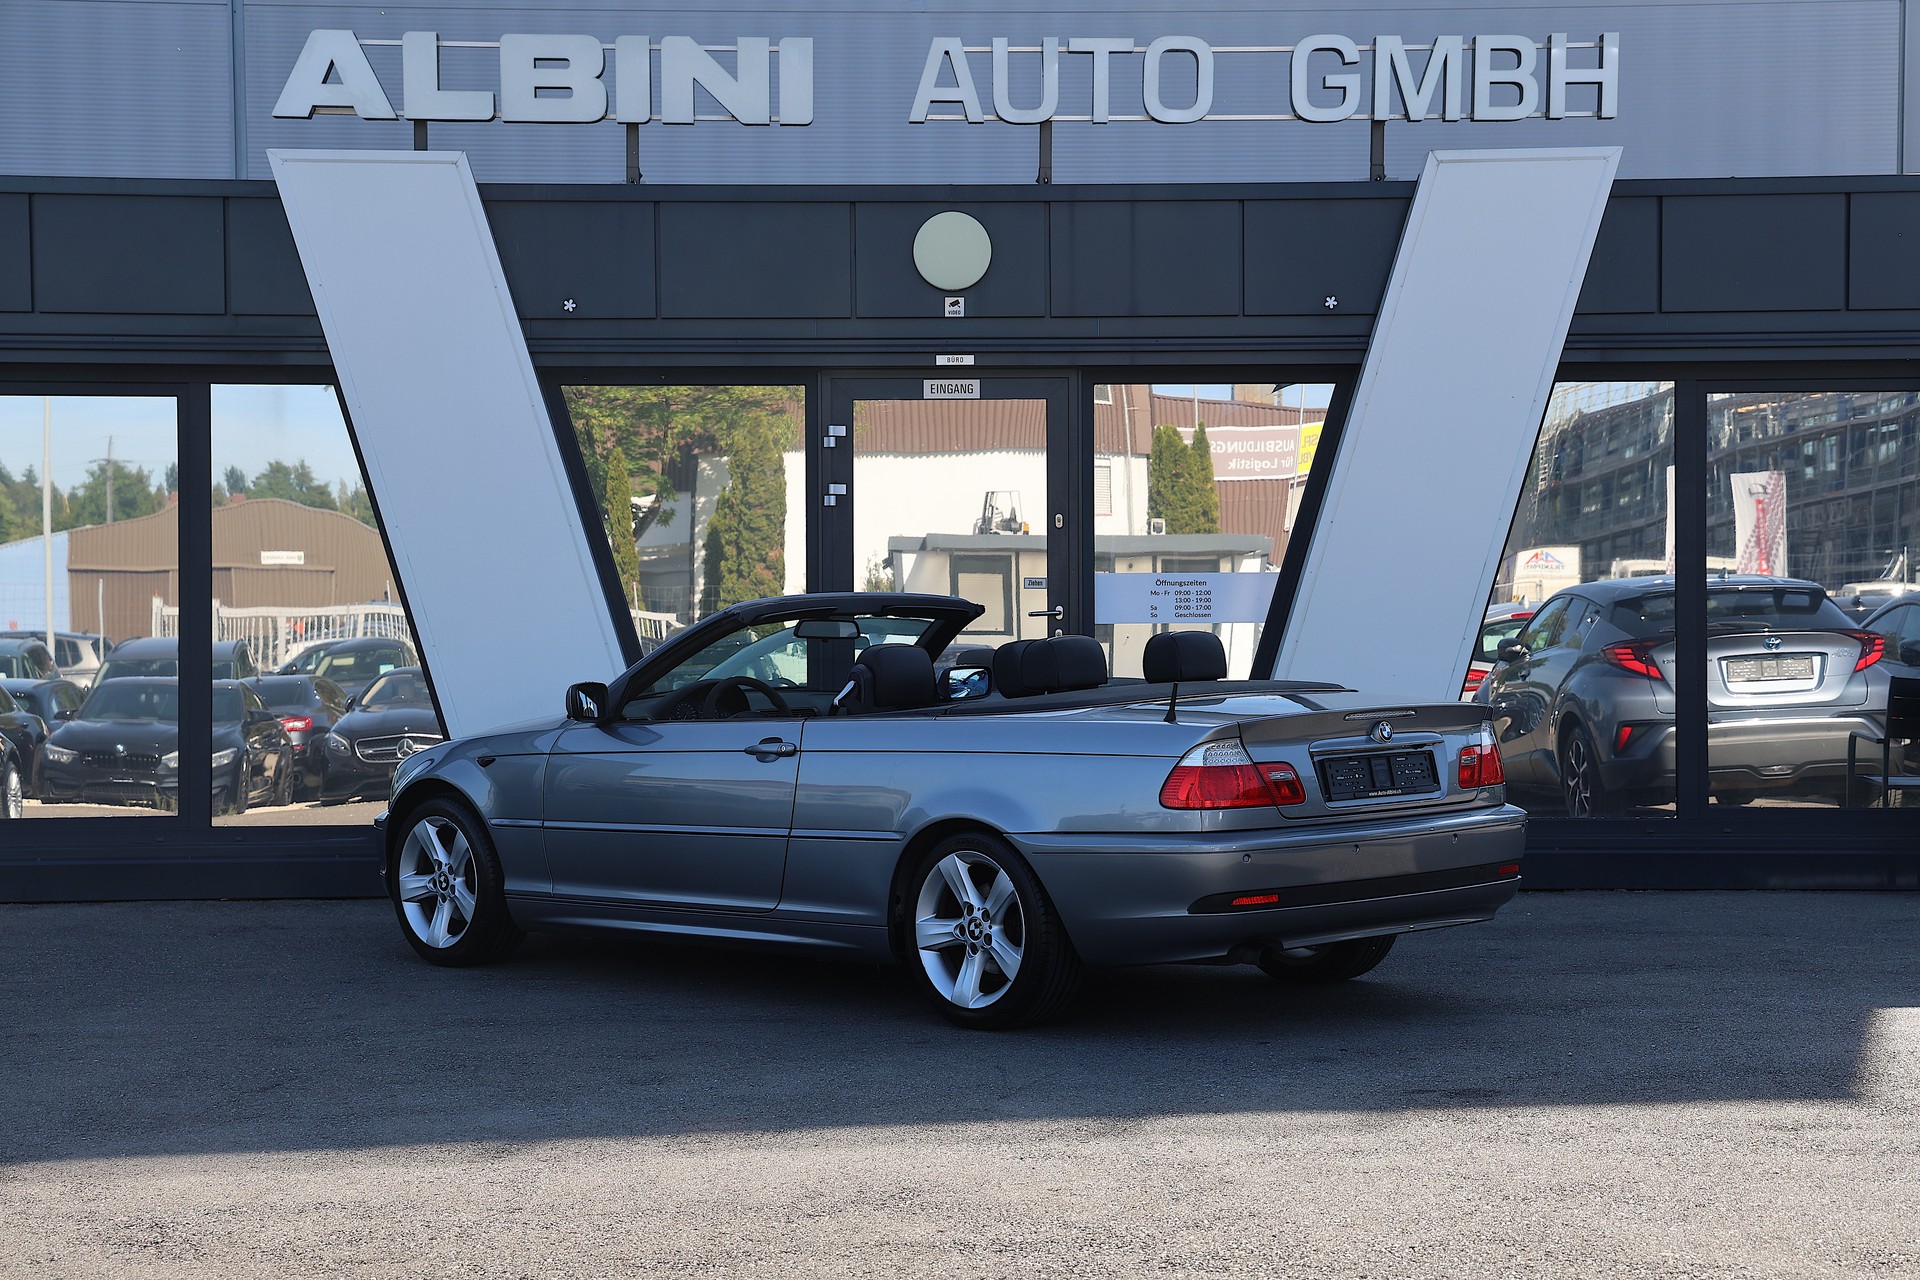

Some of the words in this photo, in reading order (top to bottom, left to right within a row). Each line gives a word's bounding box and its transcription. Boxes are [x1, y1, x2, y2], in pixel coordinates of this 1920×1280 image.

[271, 28, 815, 126] ALBINI
[908, 35, 1215, 125] AUTO
[1290, 31, 1620, 123] GMBH
[946, 355, 964, 363] BÜRO
[930, 383, 974, 395] EINGANG
[1027, 579, 1043, 587] Ziehen
[1155, 579, 1207, 587] Öffnungszeiten
